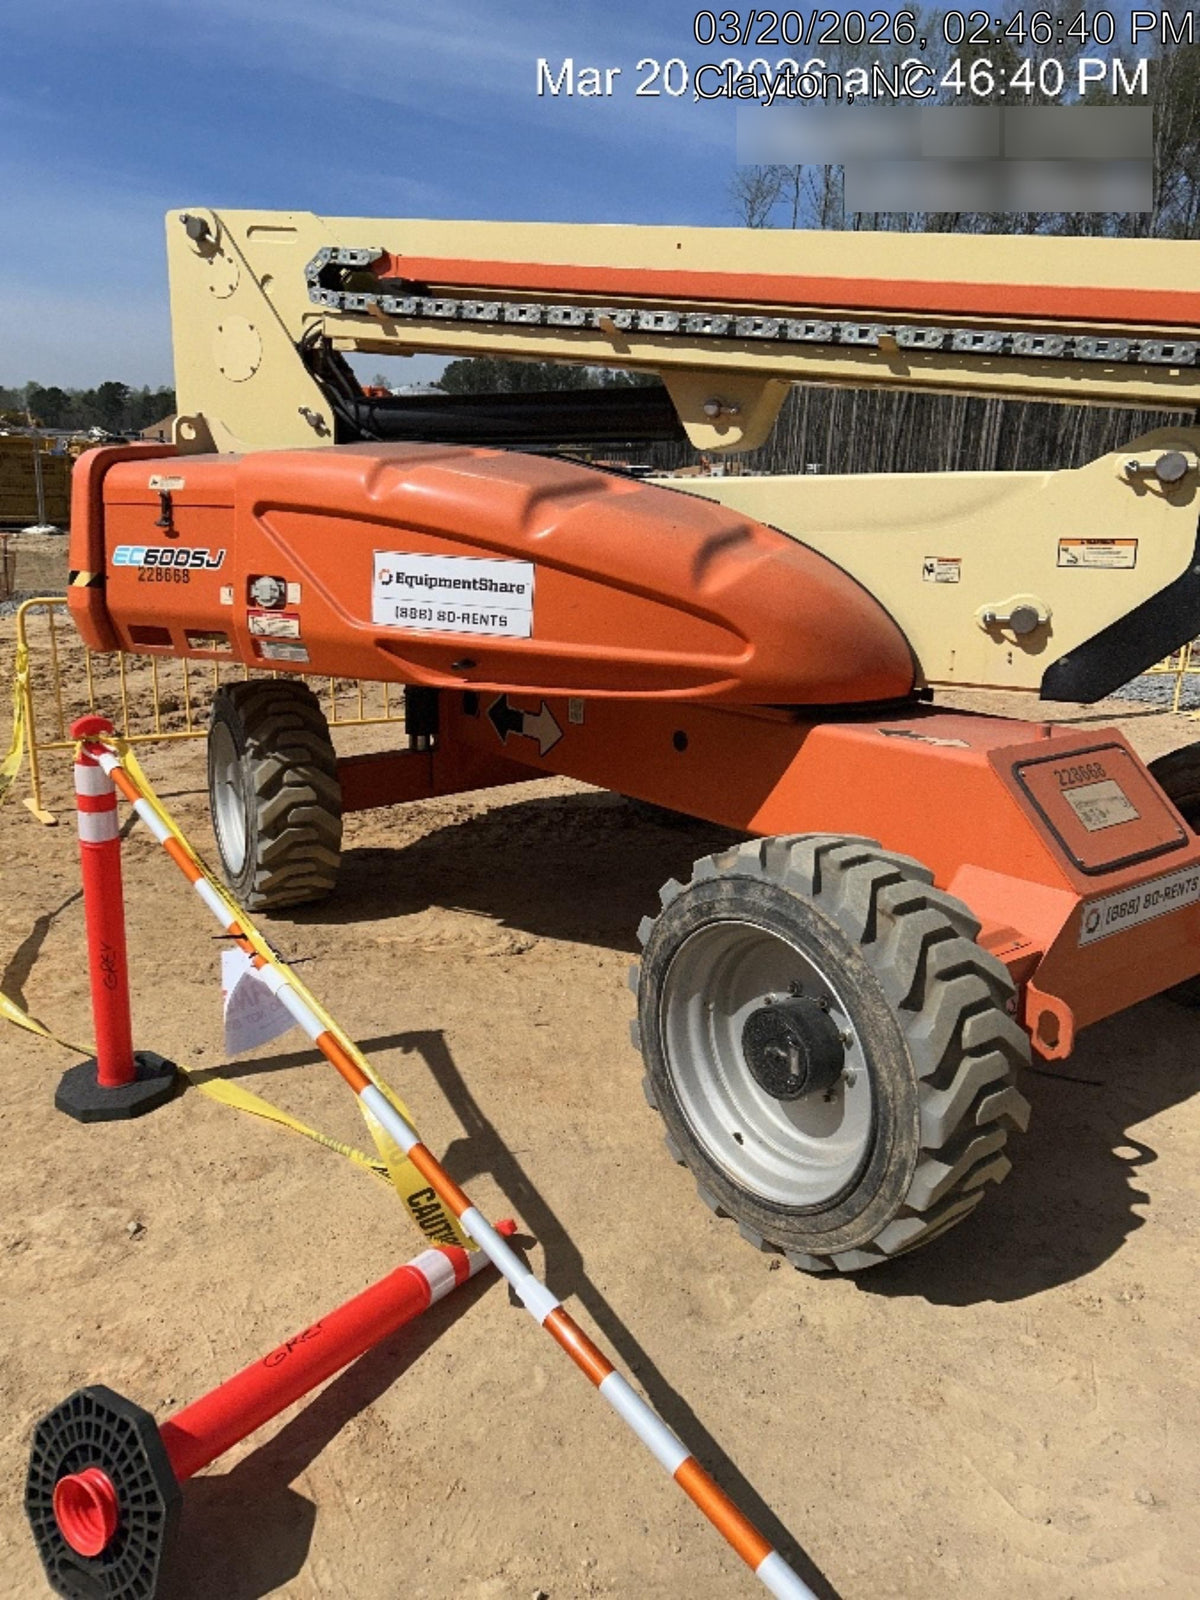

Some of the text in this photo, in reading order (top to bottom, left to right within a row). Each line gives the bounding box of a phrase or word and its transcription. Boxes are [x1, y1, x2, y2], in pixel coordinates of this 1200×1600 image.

[112, 546, 225, 568] EC600SJ
[395, 571, 526, 595] EquipmentShare
[436, 611, 508, 627] 80-RENTS
